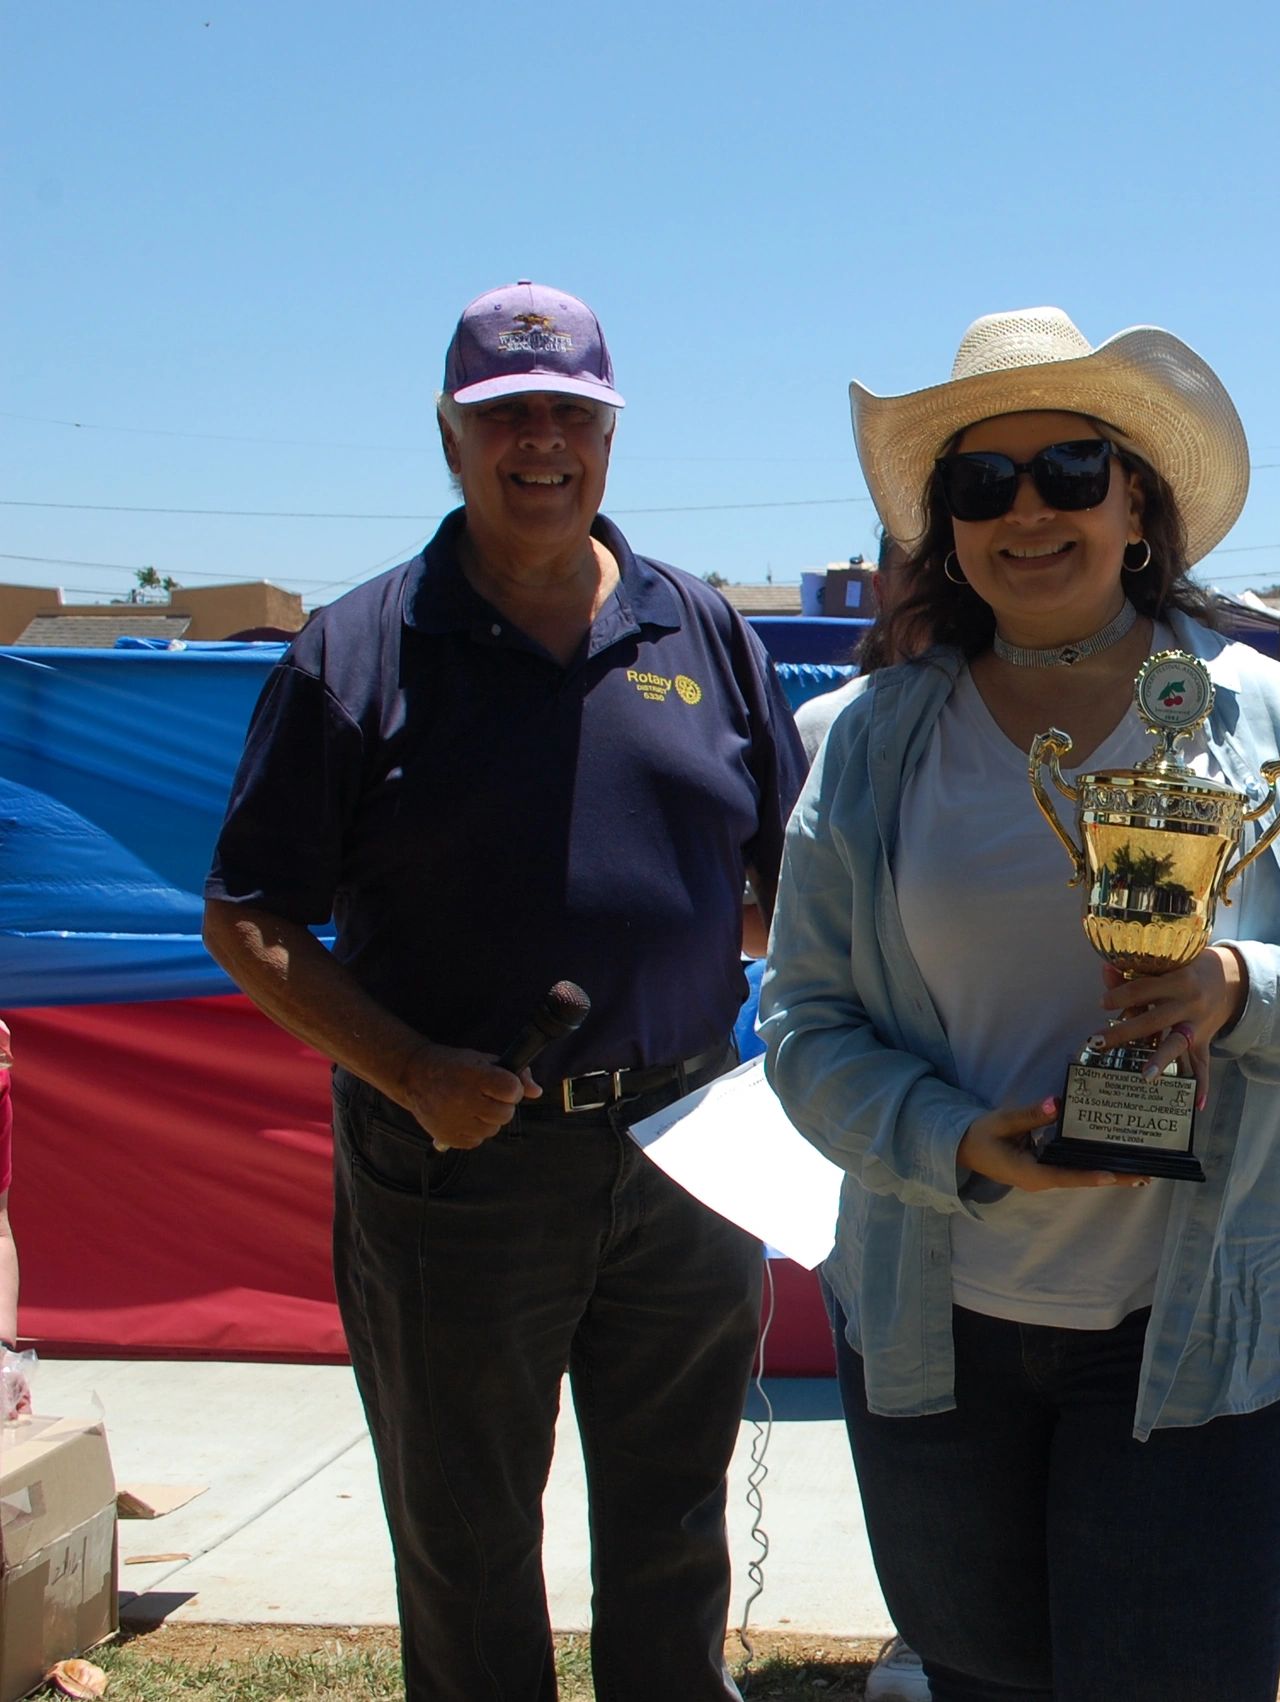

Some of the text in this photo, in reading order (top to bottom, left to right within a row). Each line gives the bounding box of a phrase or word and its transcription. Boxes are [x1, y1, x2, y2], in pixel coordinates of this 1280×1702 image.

[499, 333, 572, 347] WESTSTER
[627, 670, 672, 691] Rotary
[636, 684, 667, 695] DISTRICT
[1075, 1067, 1101, 1079] 104th
[1101, 1072, 1130, 1082] Annual
[1160, 1079, 1192, 1090] Festival
[1105, 1081, 1148, 1094] Beaumont,
[1091, 1098, 1101, 1106] So
[1102, 1098, 1123, 1109] Much
[1078, 1109, 1178, 1132] FIRST PLACE
[1089, 1123, 1162, 1137] Cherry Festival Parade
